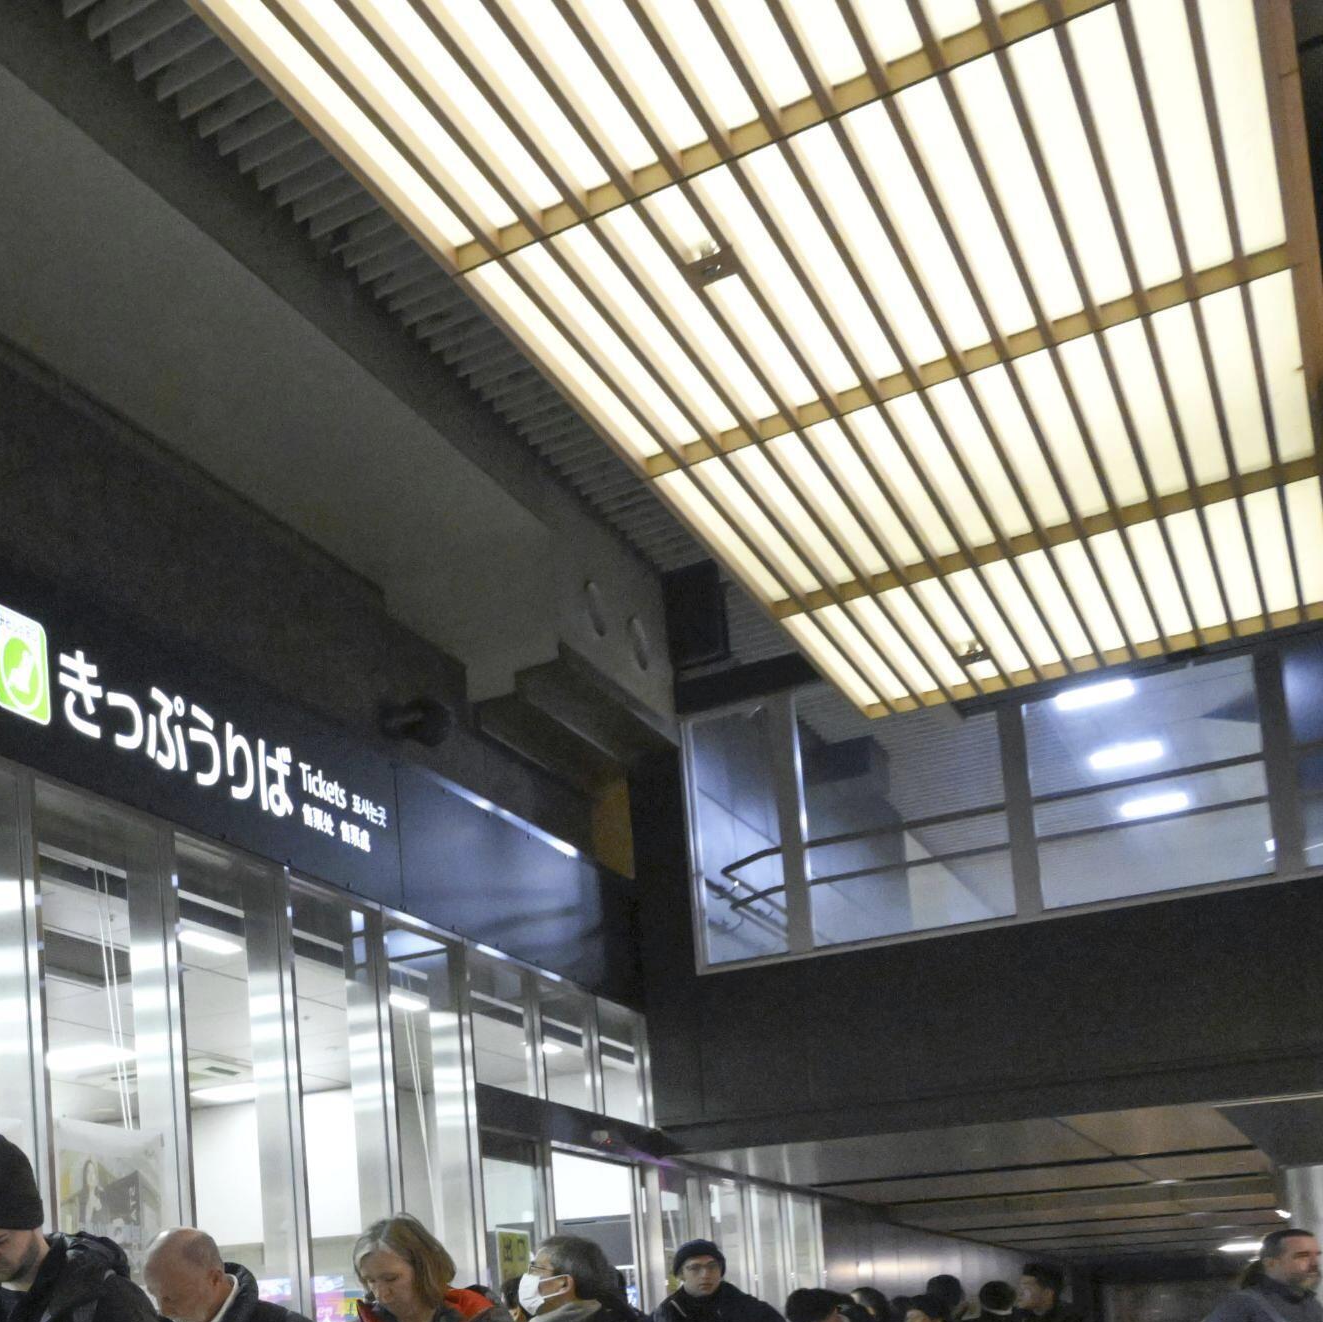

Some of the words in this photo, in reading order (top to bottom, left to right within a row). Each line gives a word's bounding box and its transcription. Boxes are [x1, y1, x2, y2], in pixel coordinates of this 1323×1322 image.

[58, 650, 293, 817] きっぷうりば
[298, 761, 347, 810] Tickets
